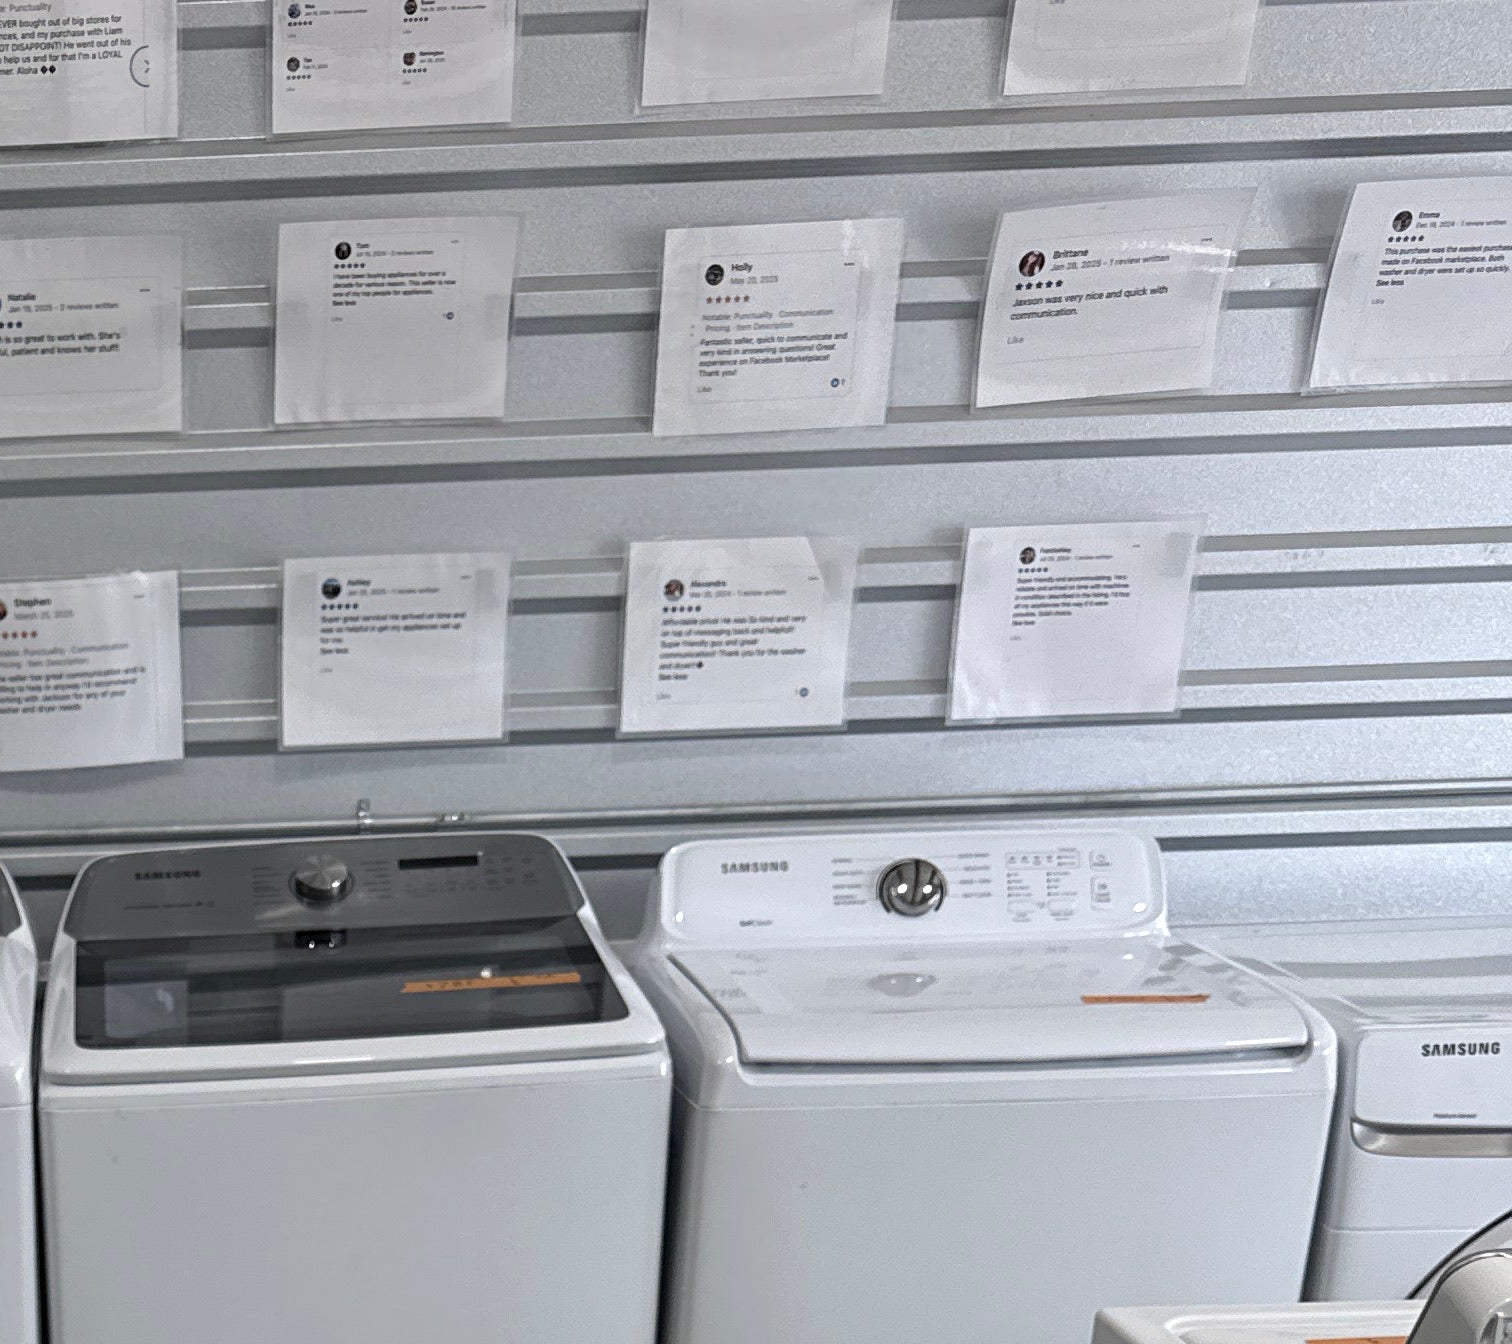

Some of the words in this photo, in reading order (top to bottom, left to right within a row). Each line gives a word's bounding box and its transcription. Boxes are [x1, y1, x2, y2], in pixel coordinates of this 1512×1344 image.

[19, 19, 46, 28] bought
[62, 18, 70, 26] of
[72, 18, 84, 26] big
[111, 15, 121, 23] for
[50, 30, 85, 39] purchase
[732, 263, 752, 272] Holly
[1045, 296, 1062, 304] was
[1065, 294, 1083, 303] very
[1106, 289, 1122, 298] and
[1124, 288, 1147, 298] quick
[721, 861, 789, 873] SAMSUNG
[134, 870, 201, 880] SAMSUNG
[1421, 1042, 1500, 1056] SAMSUNG
